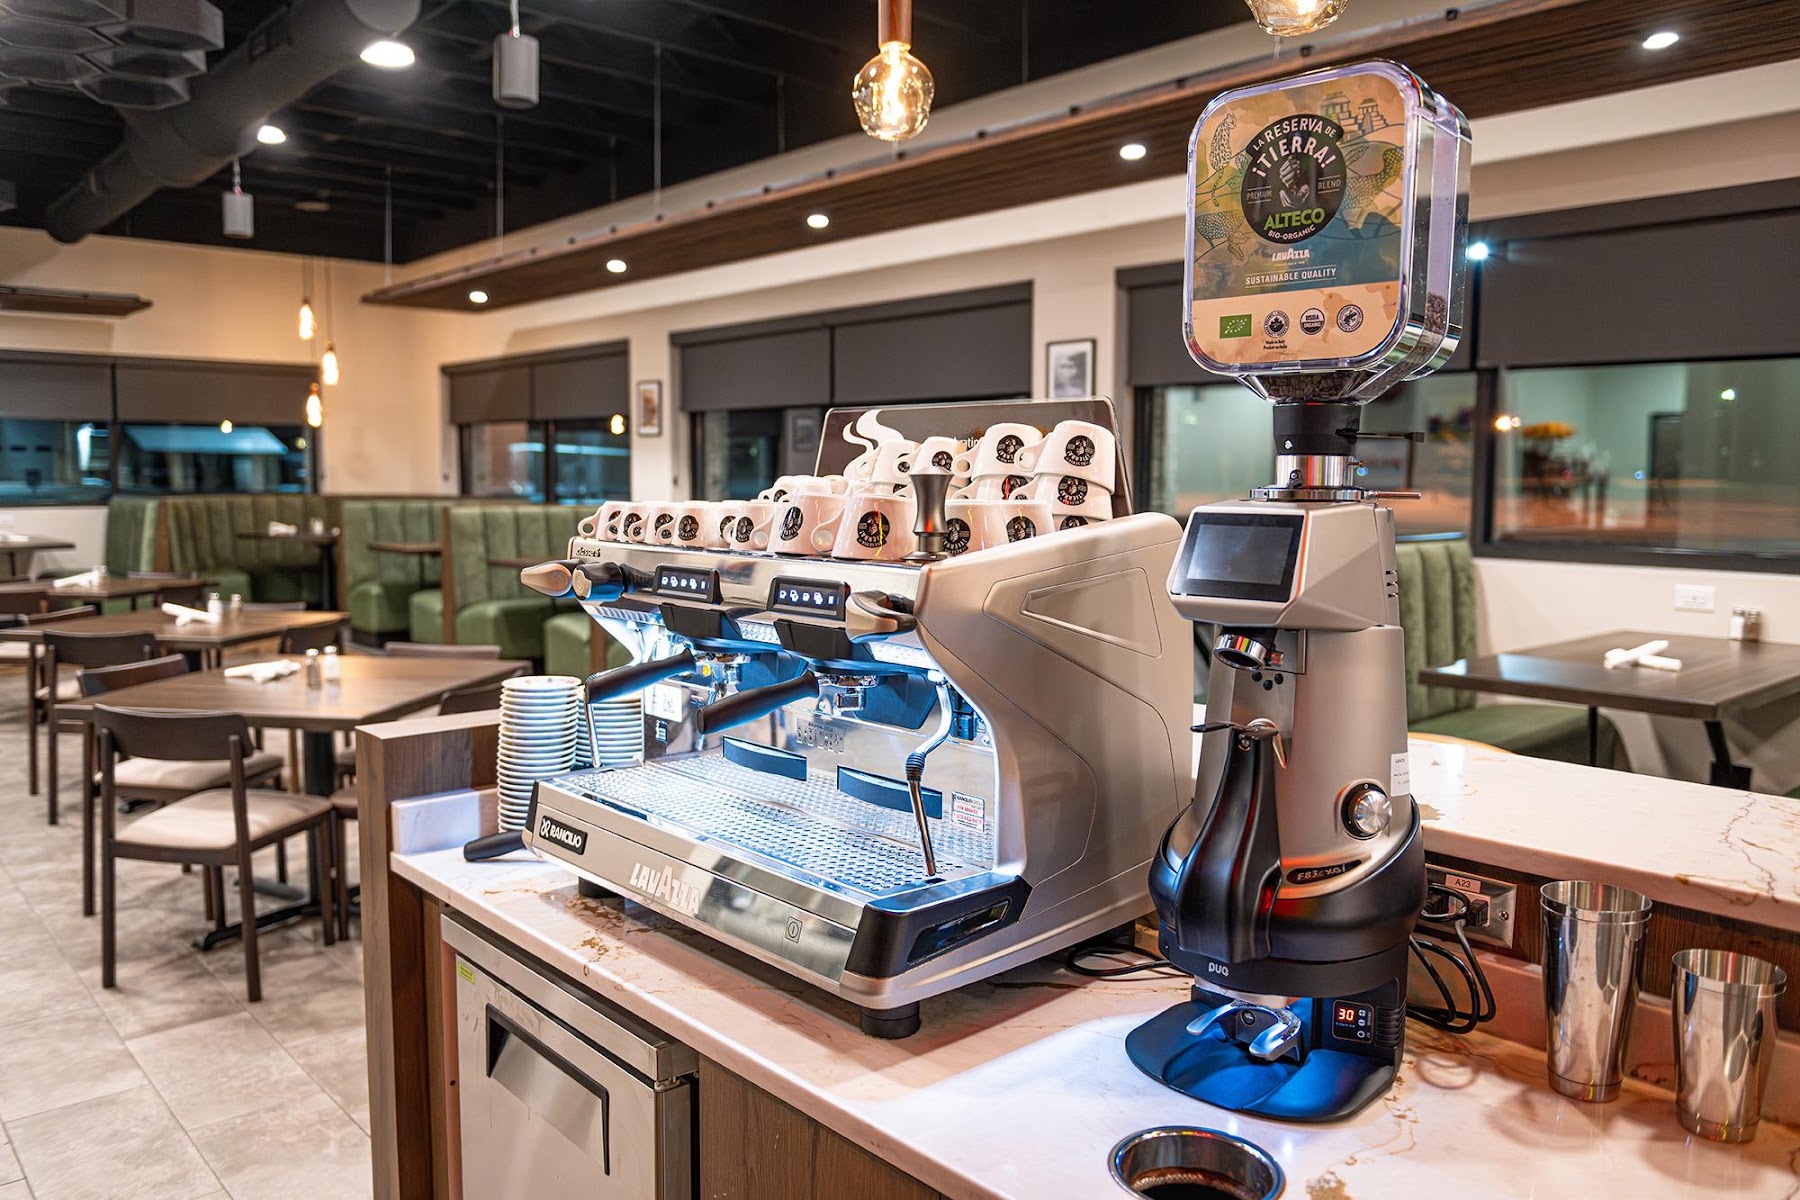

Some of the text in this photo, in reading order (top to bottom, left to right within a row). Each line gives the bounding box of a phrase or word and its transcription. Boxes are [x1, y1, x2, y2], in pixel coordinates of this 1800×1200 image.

[1252, 118, 1337, 151] LA RESERVA DE
[1317, 179, 1341, 190] BLEND
[1246, 190, 1272, 200] PREMIUM
[1263, 207, 1326, 231] ALTECO
[1267, 224, 1316, 240] BIO-ORGANIC
[1245, 268, 1337, 285] SUSTAINABLE QUALITY
[550, 825, 583, 849] RANCILIO
[629, 862, 702, 915] LAVAZZA
[1454, 878, 1471, 888] A23
[1338, 1008, 1355, 1021] 30
